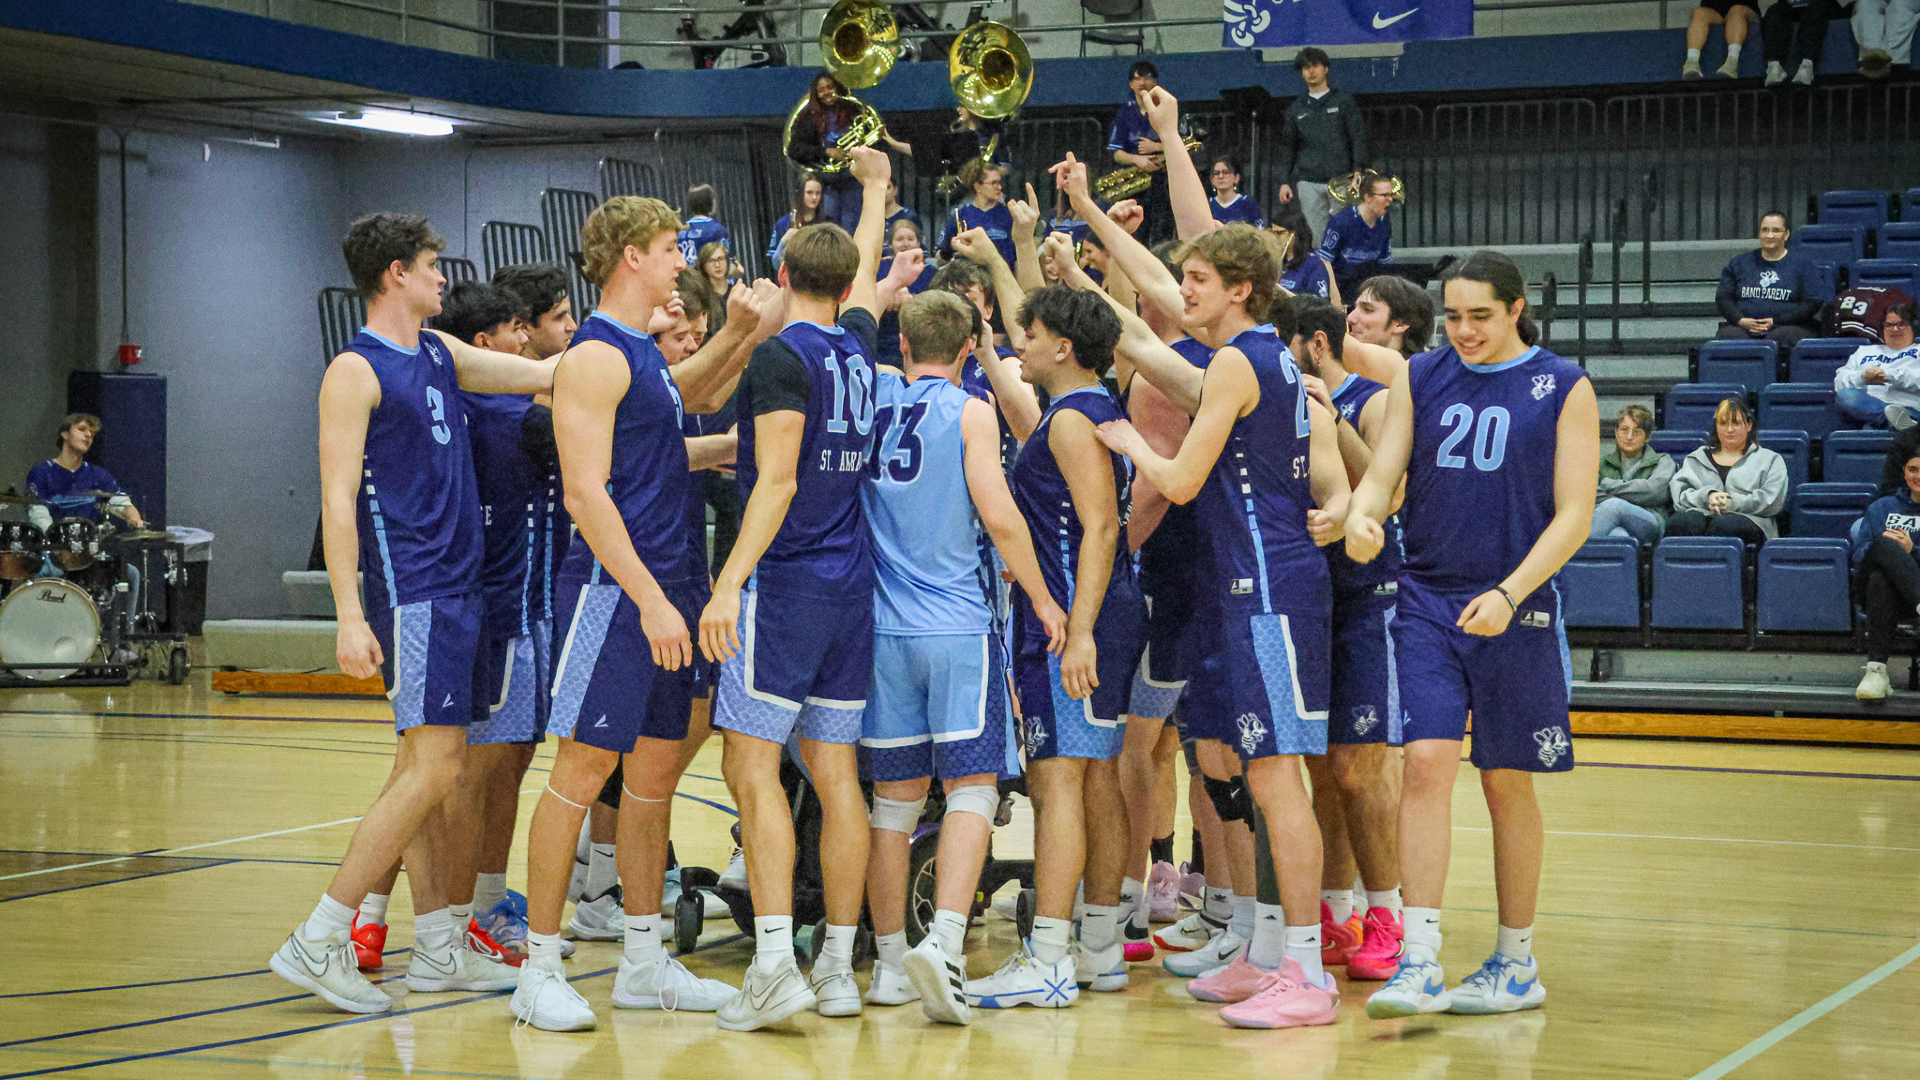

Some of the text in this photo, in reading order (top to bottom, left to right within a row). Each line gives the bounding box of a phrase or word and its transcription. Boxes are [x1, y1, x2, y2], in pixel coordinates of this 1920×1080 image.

[1741, 286, 1792, 301] BAND PARENT
[824, 348, 874, 436] 10
[426, 385, 452, 445] 3
[1436, 402, 1511, 472] 20
[819, 449, 834, 471] ST.
[1292, 455, 1308, 479] ST.
